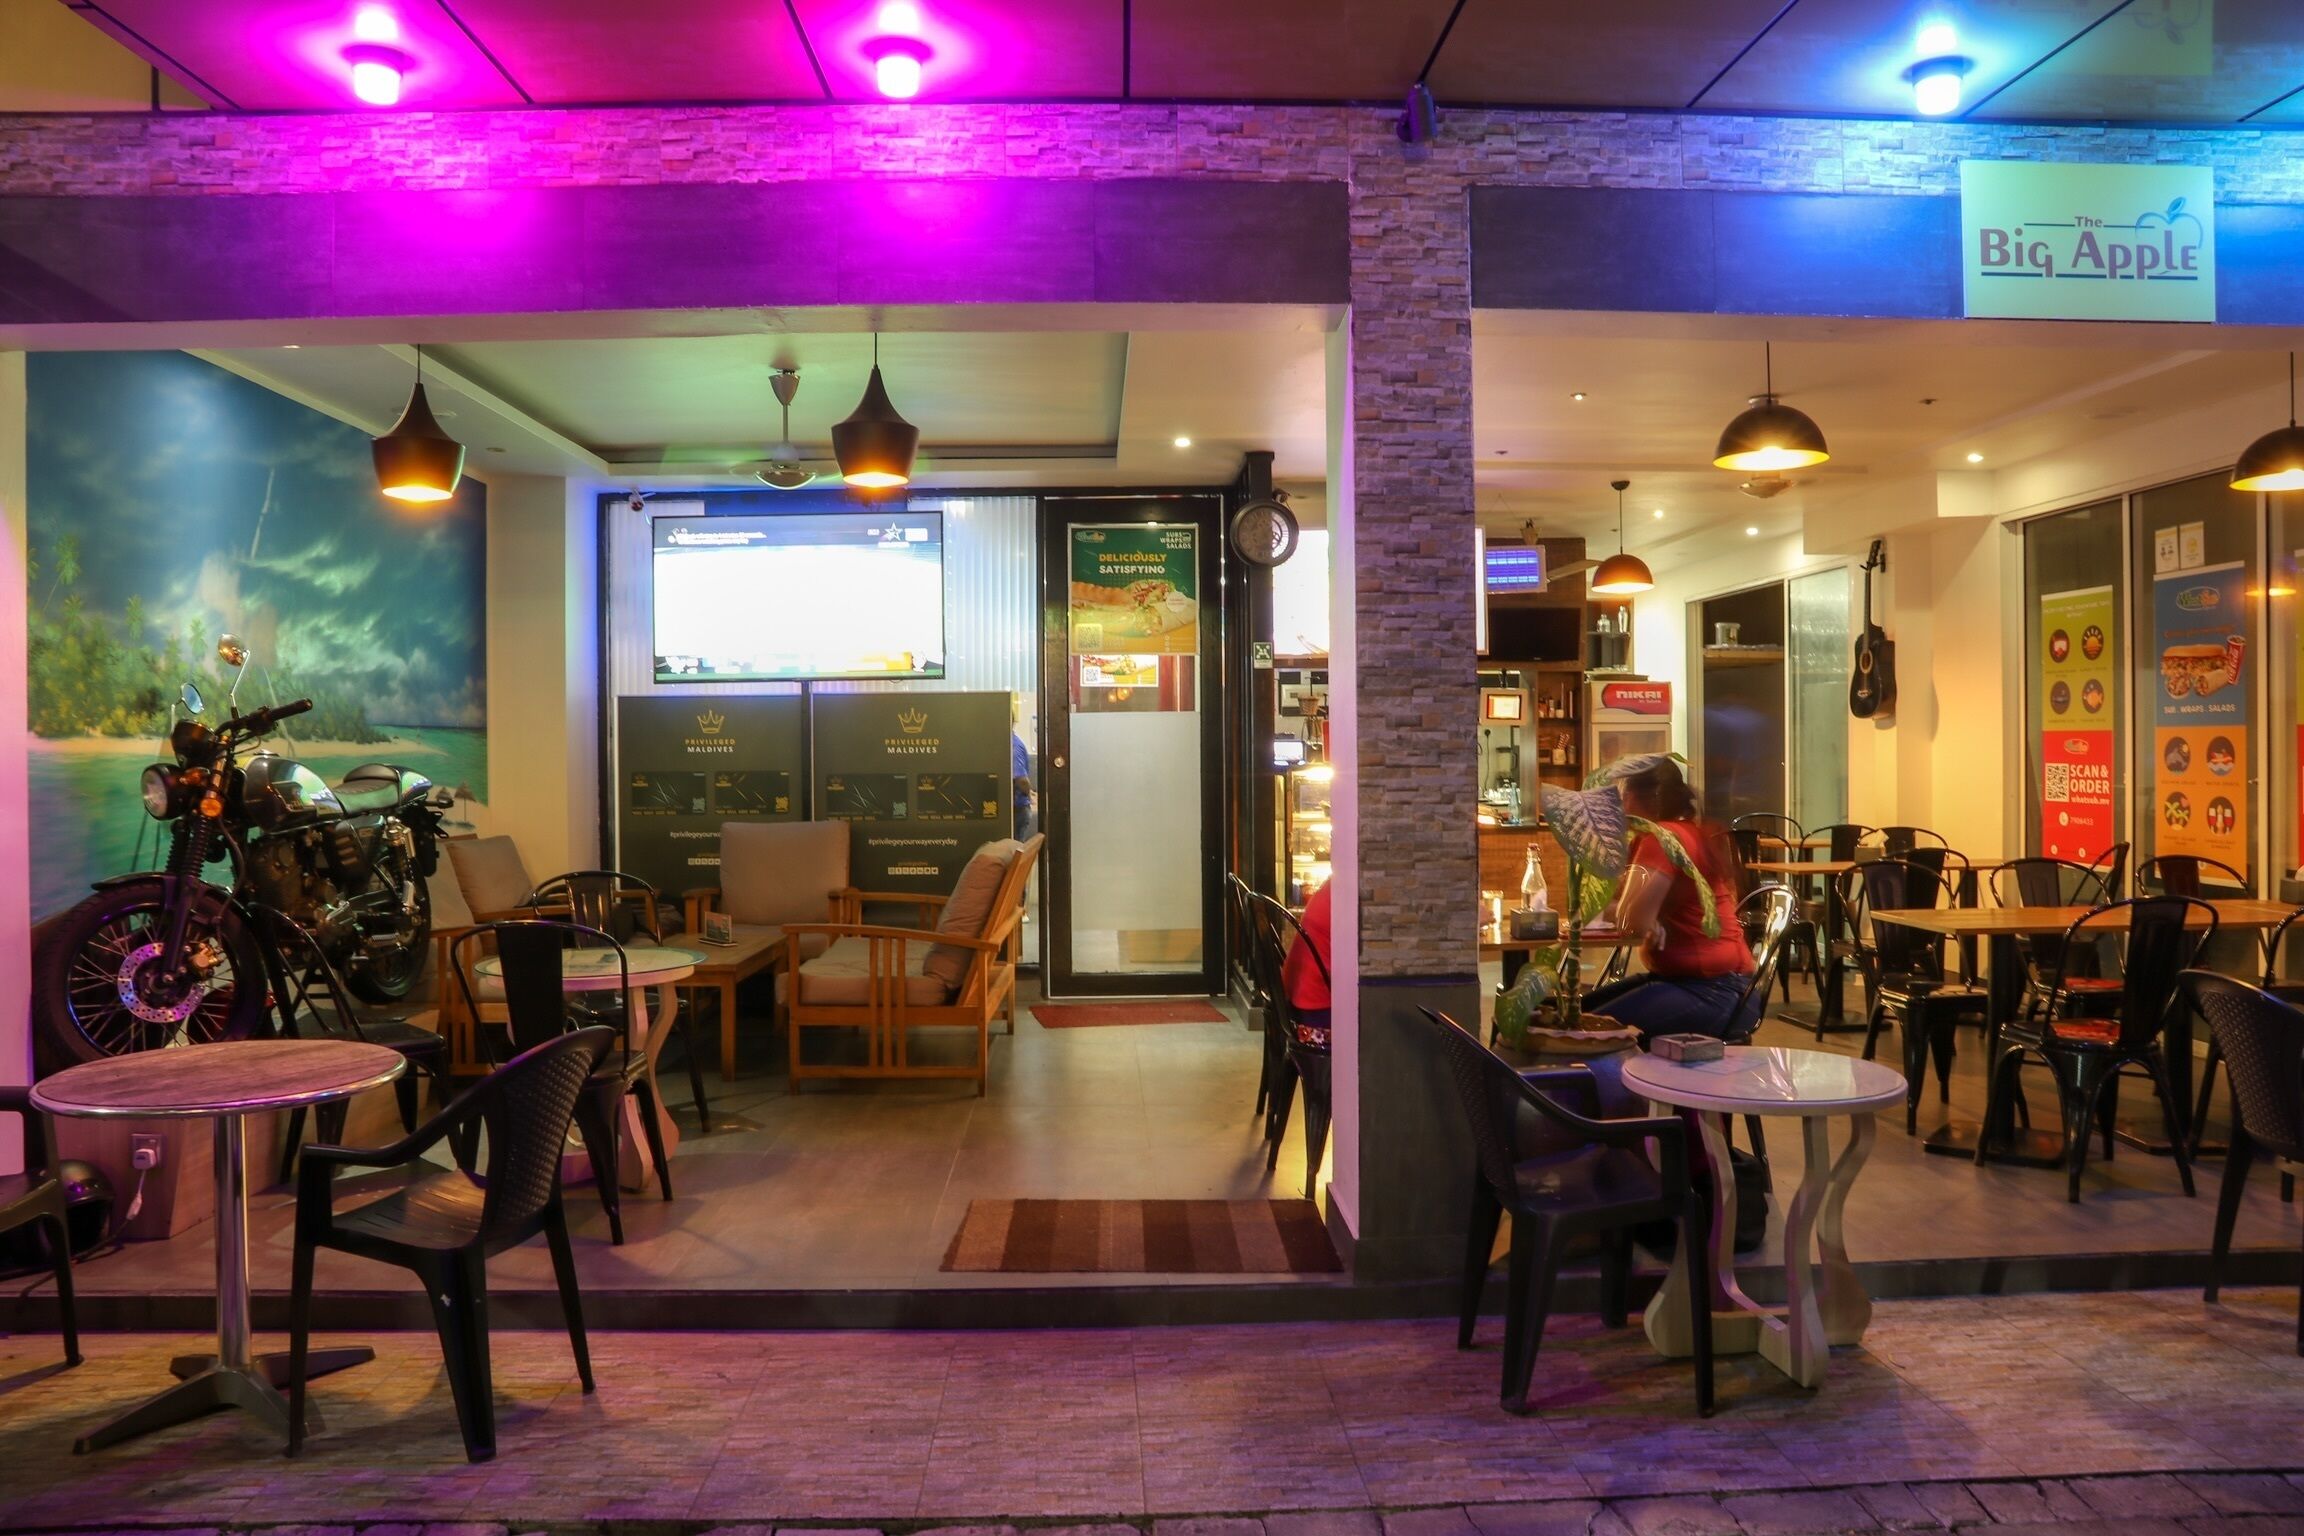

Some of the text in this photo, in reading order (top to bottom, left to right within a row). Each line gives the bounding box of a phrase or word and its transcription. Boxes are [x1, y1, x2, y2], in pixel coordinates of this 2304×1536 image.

[2074, 216, 2103, 227] The
[1980, 227, 2198, 280] Big Apple
[1098, 553, 1167, 563] DELICIOUSLY
[1098, 565, 1166, 575] SATISFYING
[1615, 690, 1662, 699] NIKAI
[685, 738, 736, 746] PRIVILEGED
[884, 738, 940, 746] PRIVILEGED
[887, 746, 937, 754] MALDIVES
[2070, 778, 2110, 795] ORDER
